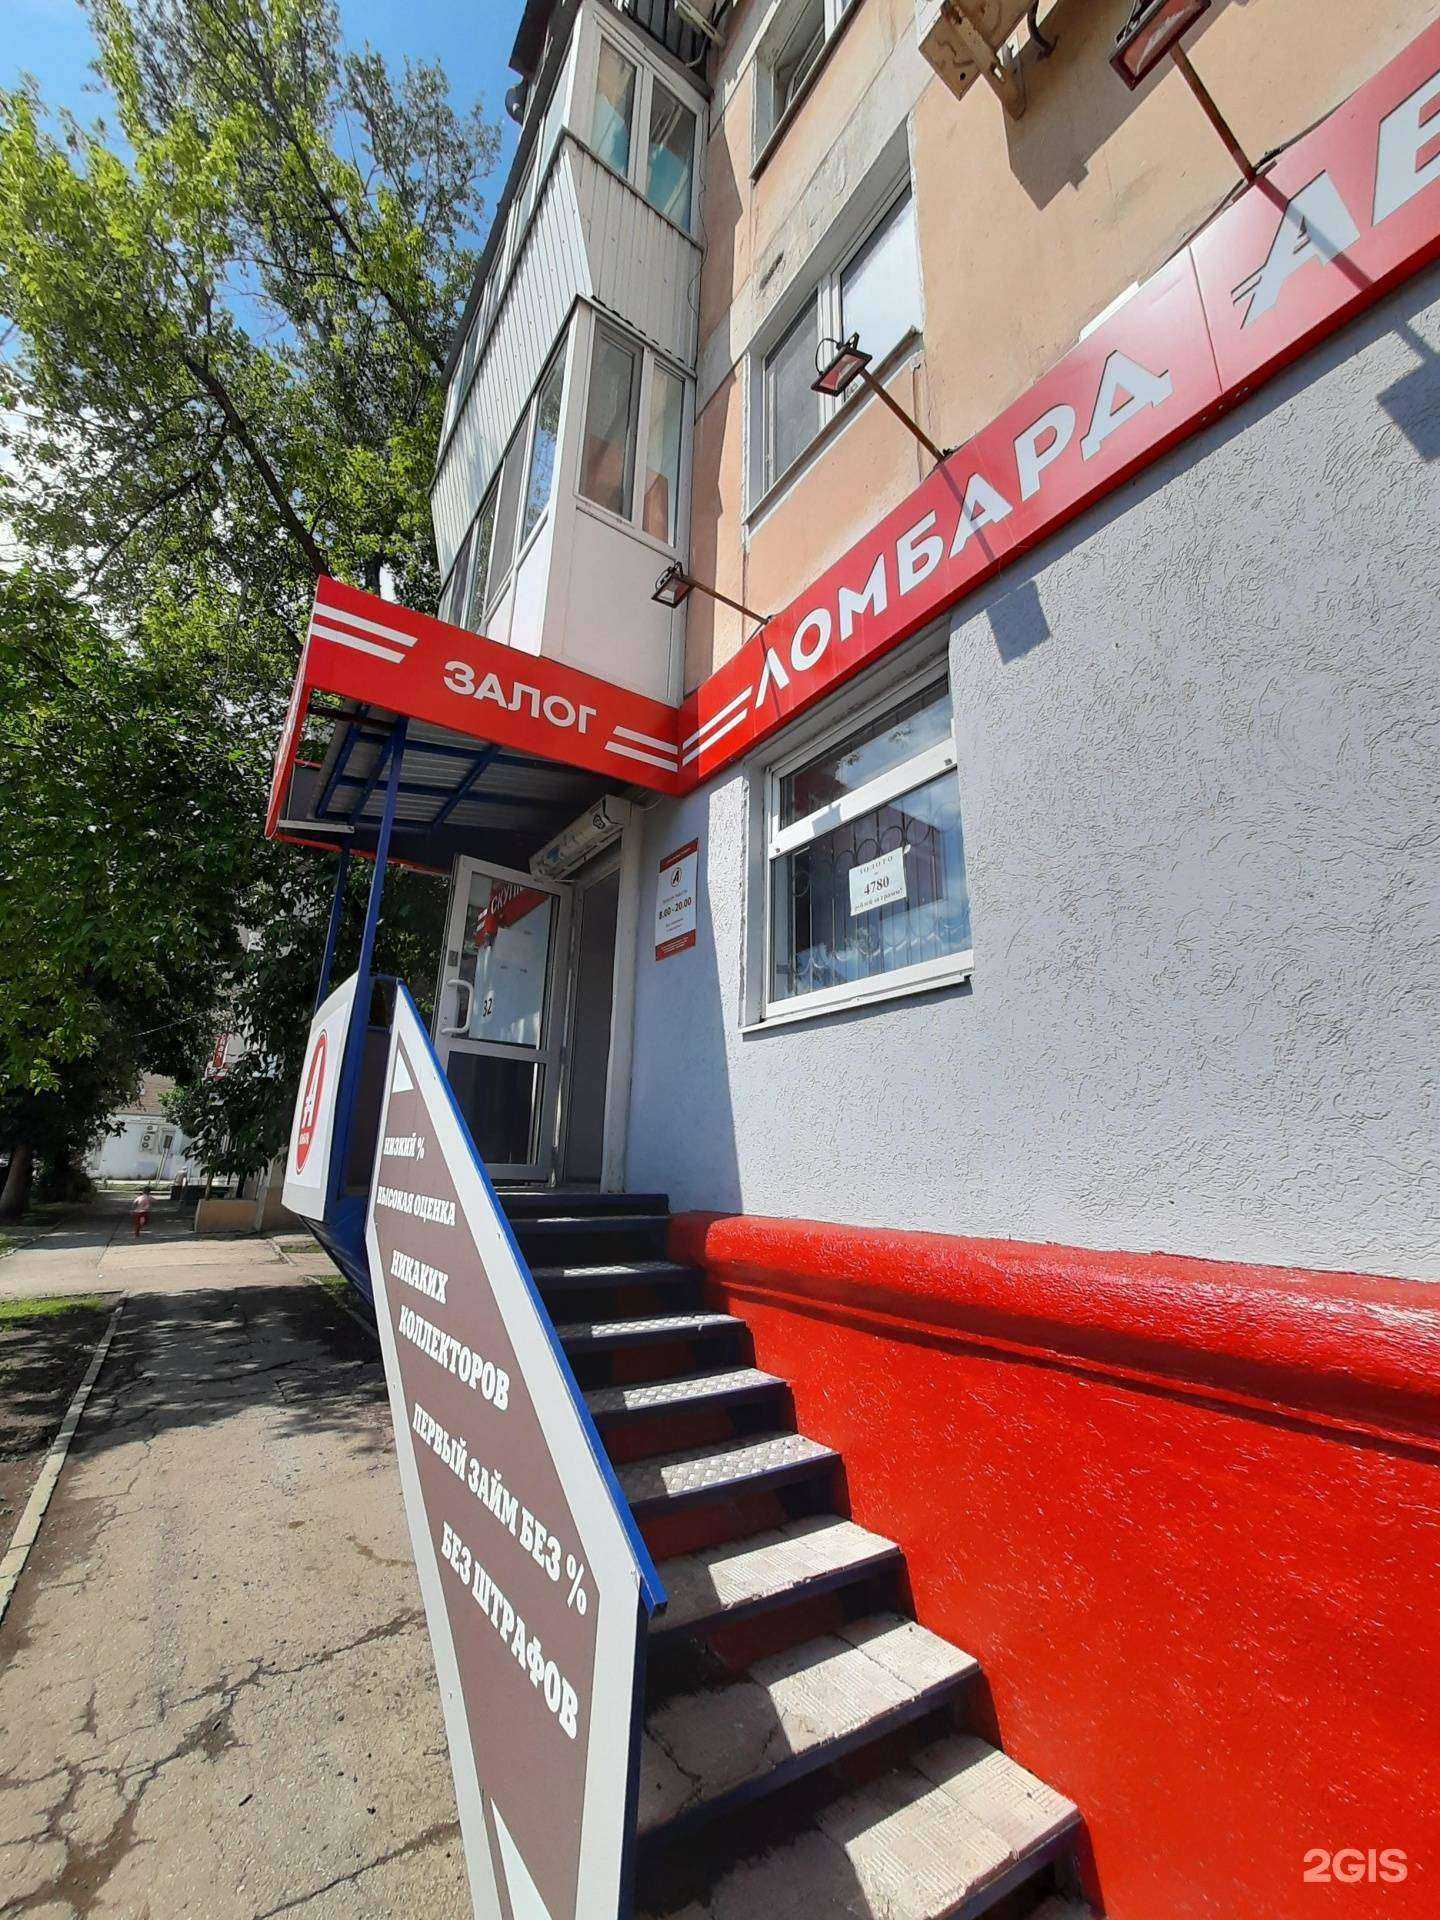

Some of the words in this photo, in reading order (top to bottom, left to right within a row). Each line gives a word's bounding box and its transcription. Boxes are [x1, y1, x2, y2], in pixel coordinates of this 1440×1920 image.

[755, 349, 1173, 710] ЛОМБАРД
[443, 660, 597, 734] ЗАЛОГ
[864, 876, 890, 896] 4780
[377, 1186, 414, 1214] ВЫСОКАЯ
[413, 1194, 456, 1227] ОЦЕНКА
[390, 1250, 448, 1305] НИКАКИХ
[398, 1304, 510, 1411] КОЛЛЕКТОРОВ
[412, 1402, 469, 1482] ПЕРВЫЙ
[468, 1458, 518, 1536] ЗАЙМ
[521, 1506, 562, 1582] БЕЗ
[566, 1554, 587, 1615] %
[441, 1520, 471, 1586] БЕЗ
[472, 1560, 579, 1740] ШТРАФОВ
